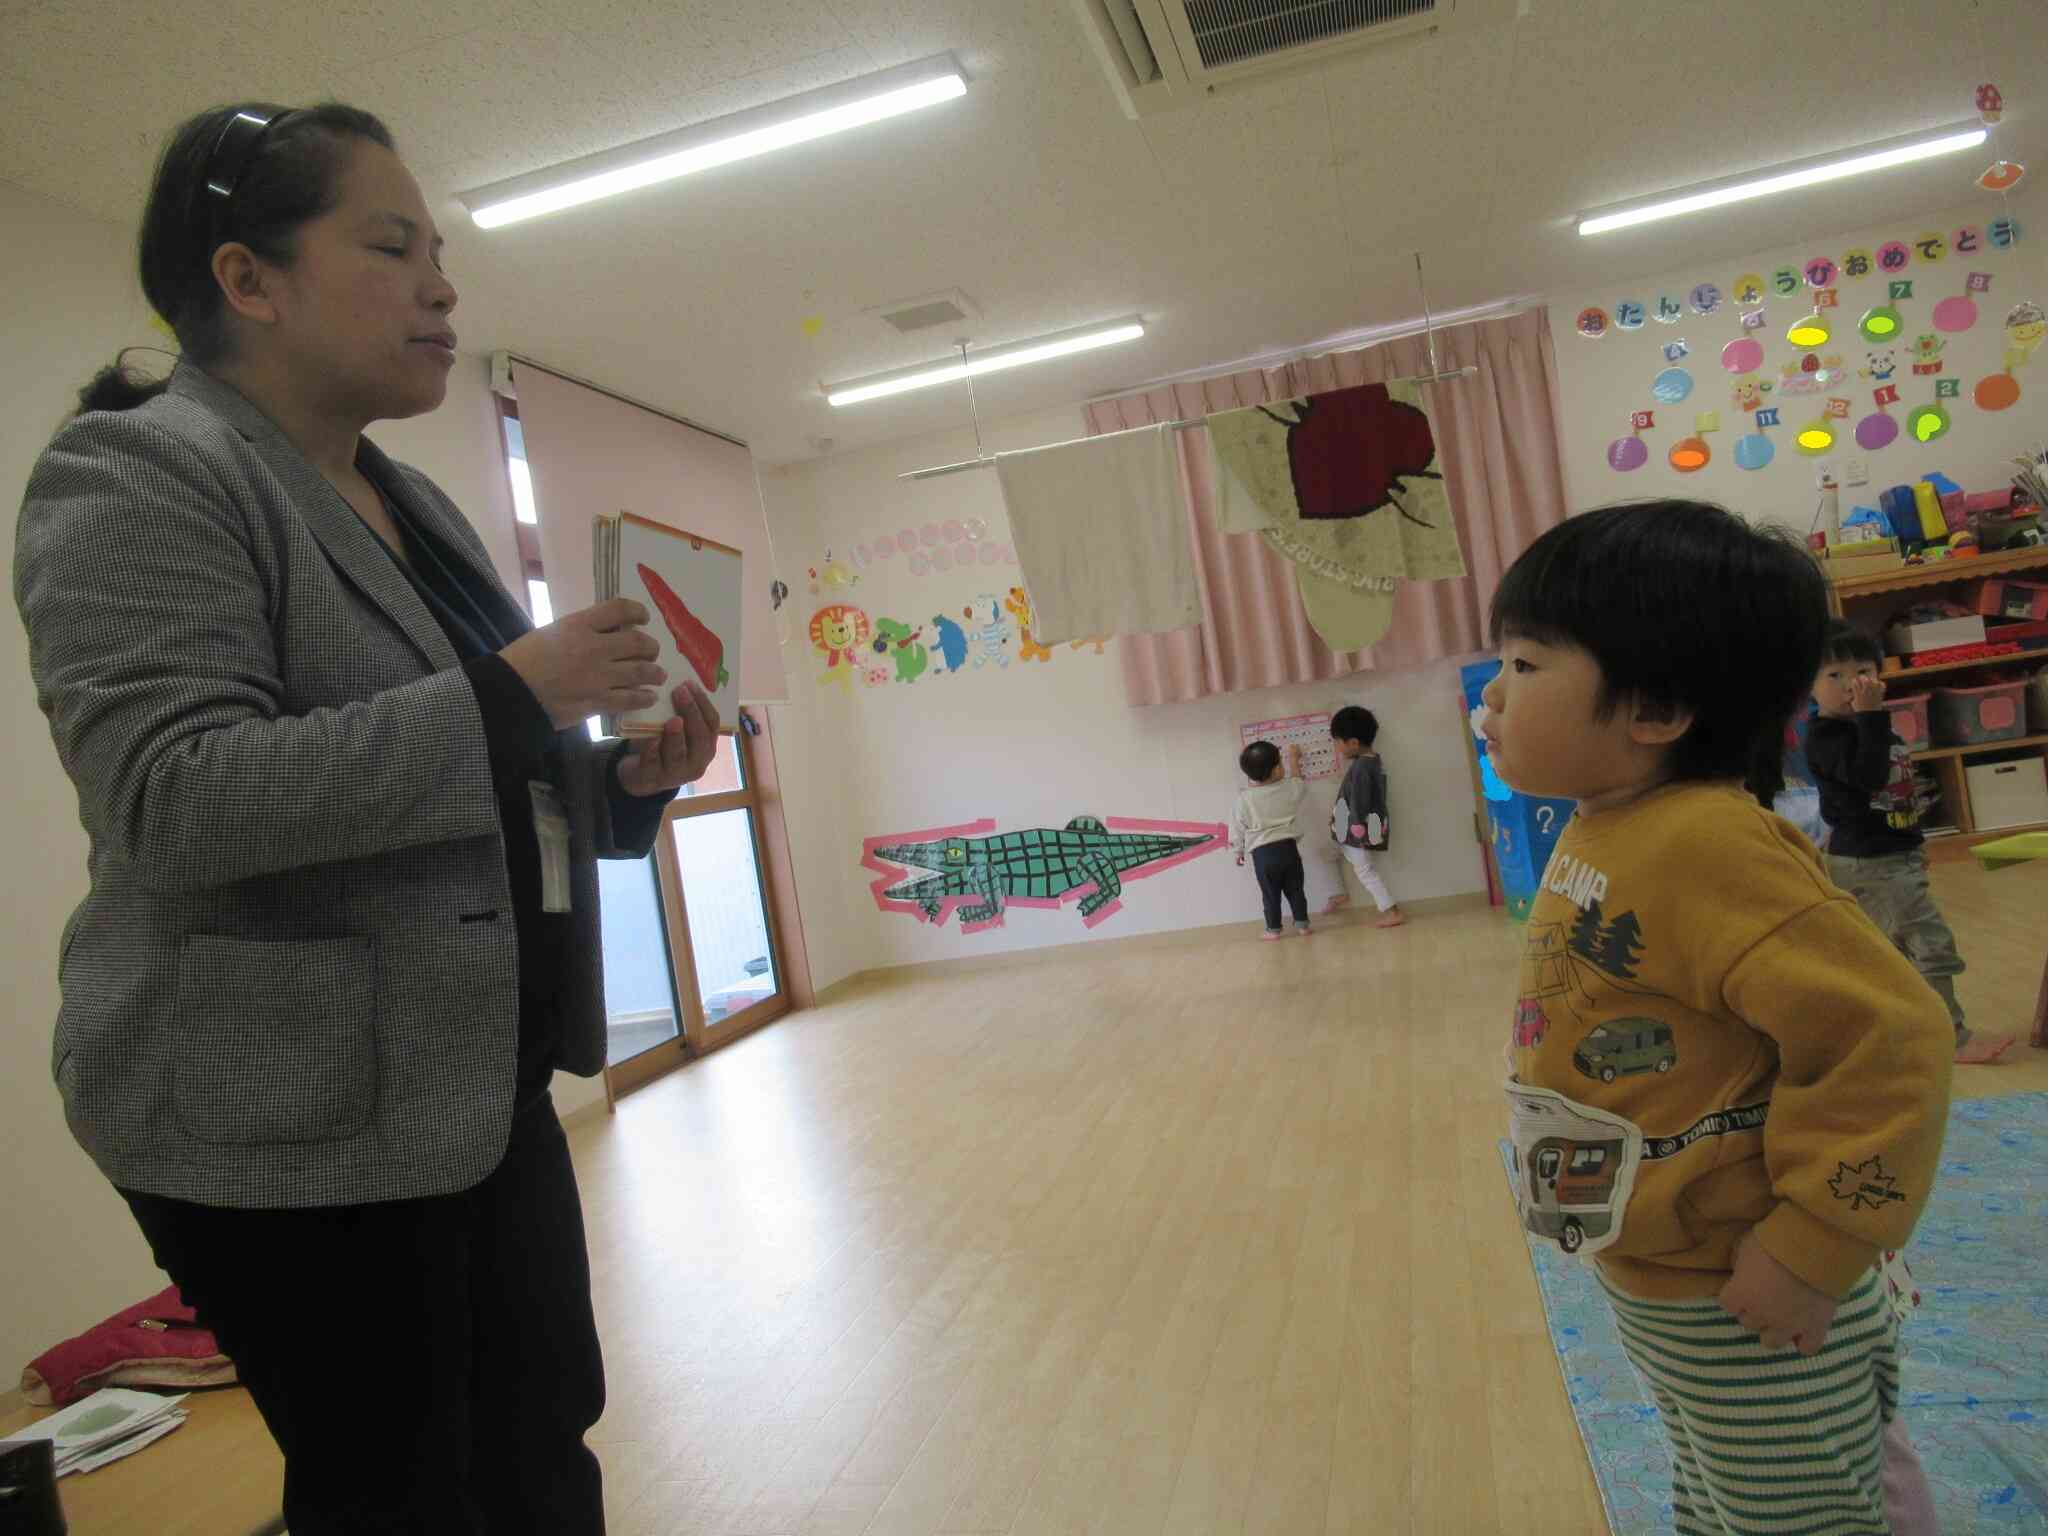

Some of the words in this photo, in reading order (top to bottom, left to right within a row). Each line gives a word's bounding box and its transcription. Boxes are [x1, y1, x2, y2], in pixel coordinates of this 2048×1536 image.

[1894, 283, 1906, 297] 7
[1941, 382, 1952, 395] 2
[1880, 389, 1889, 401] 1
[1759, 412, 1774, 424] 11
